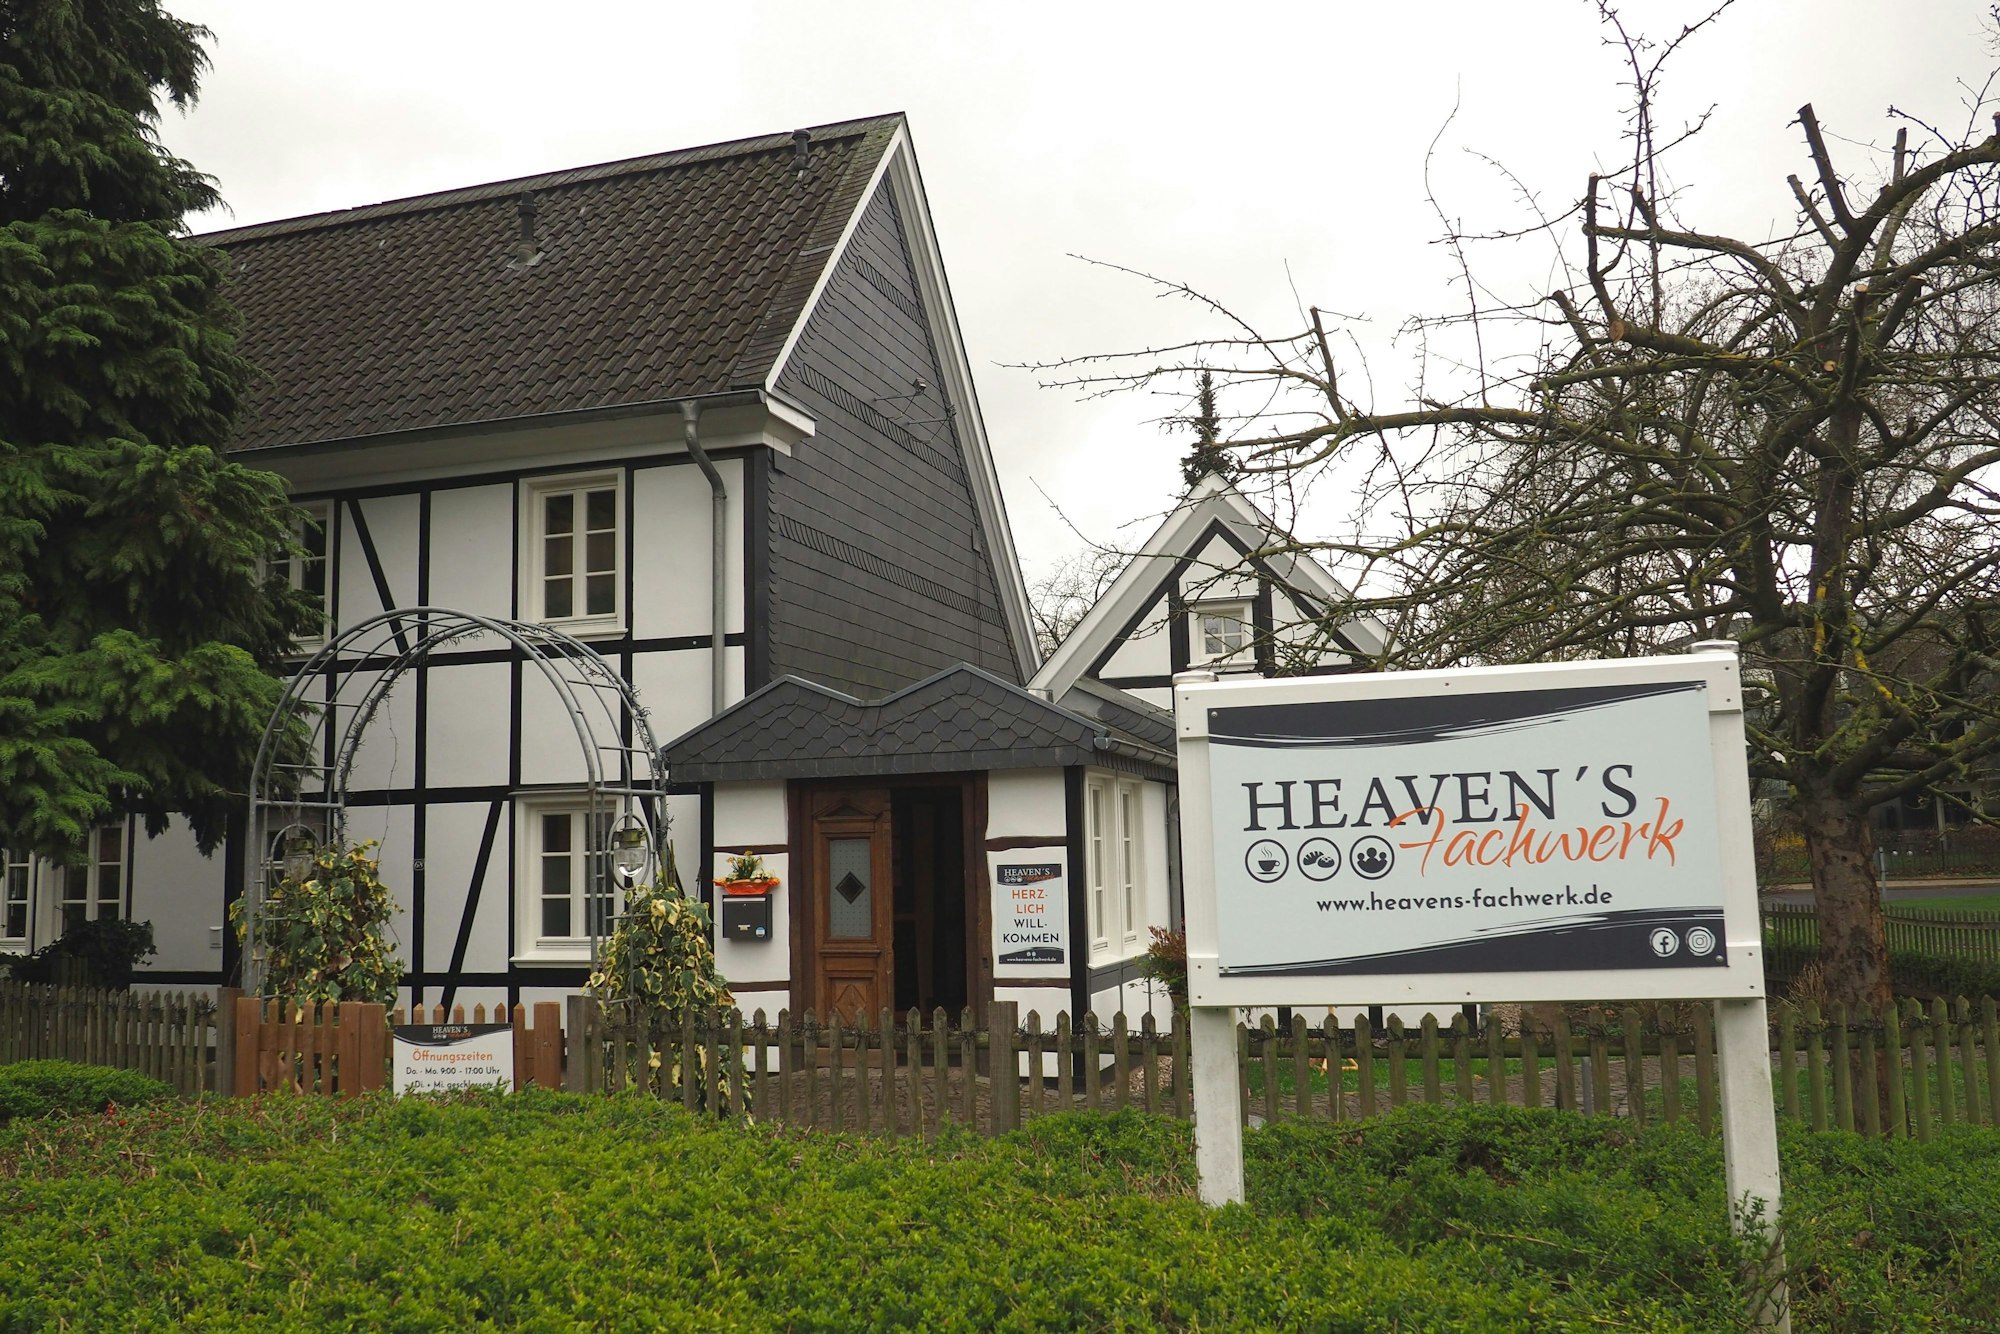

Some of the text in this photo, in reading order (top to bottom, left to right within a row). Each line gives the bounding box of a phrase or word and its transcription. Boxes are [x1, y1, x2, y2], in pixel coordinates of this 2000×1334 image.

[1390, 796, 1685, 877] Fachwerk
[1012, 889, 1048, 899] HERZ-
[1316, 884, 1613, 912] www.heavens-fachwerk.de
[1016, 904, 1044, 914] LICH
[1014, 918, 1047, 928] WILL-
[1003, 933, 1059, 943] KOMMEN
[413, 1048, 493, 1063] Öffnungszeiten
[406, 1066, 418, 1075] Do.
[425, 1066, 438, 1075] Mo.
[440, 1067, 457, 1075] 9:00
[465, 1066, 484, 1075] 17:00
[486, 1066, 500, 1075] Uhr
